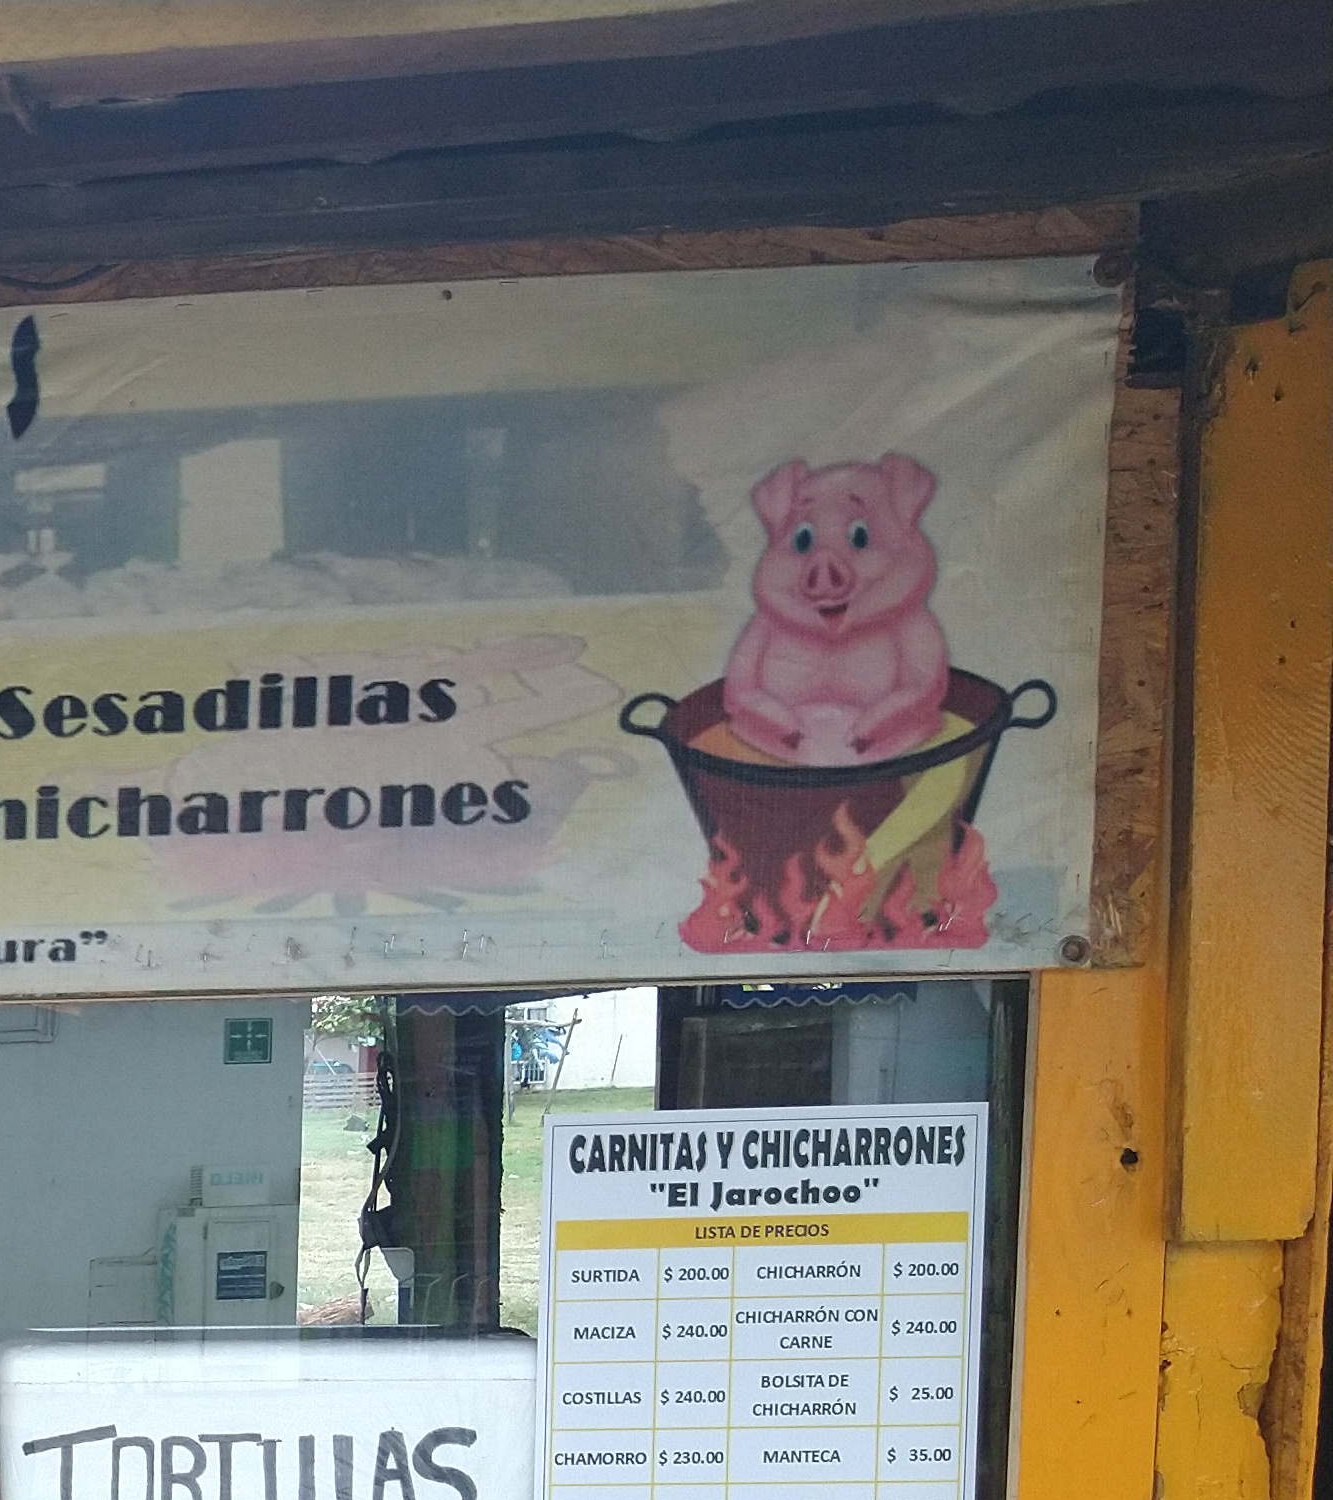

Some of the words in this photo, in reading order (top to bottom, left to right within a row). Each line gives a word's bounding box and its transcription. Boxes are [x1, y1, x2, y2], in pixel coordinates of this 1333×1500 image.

[568, 1131, 708, 1174] CARNITAS
[715, 1131, 734, 1170] Y
[742, 1124, 966, 1170] CHICHARRONES
[695, 1226, 735, 1240] LISTA
[741, 1225, 760, 1238] DE
[765, 1224, 829, 1238] PRECIOS
[571, 1269, 640, 1283] SURTIDA
[757, 1261, 861, 1279] CHICHARRÓN
[735, 1306, 840, 1324] CHICHARRÓN
[844, 1308, 878, 1322] CON
[573, 1326, 636, 1340] MACIZA
[780, 1335, 832, 1349] CARNE
[761, 1374, 825, 1389] BOLSITA
[828, 1374, 849, 1387] DE
[562, 1391, 641, 1405] COSTILLAS
[912, 1386, 954, 1400] 25.00
[752, 1399, 856, 1417] CHICHARRÓN
[554, 1452, 647, 1466] CHAMORRO
[763, 1450, 841, 1463] MANTECA
[909, 1448, 951, 1462] 35.00
